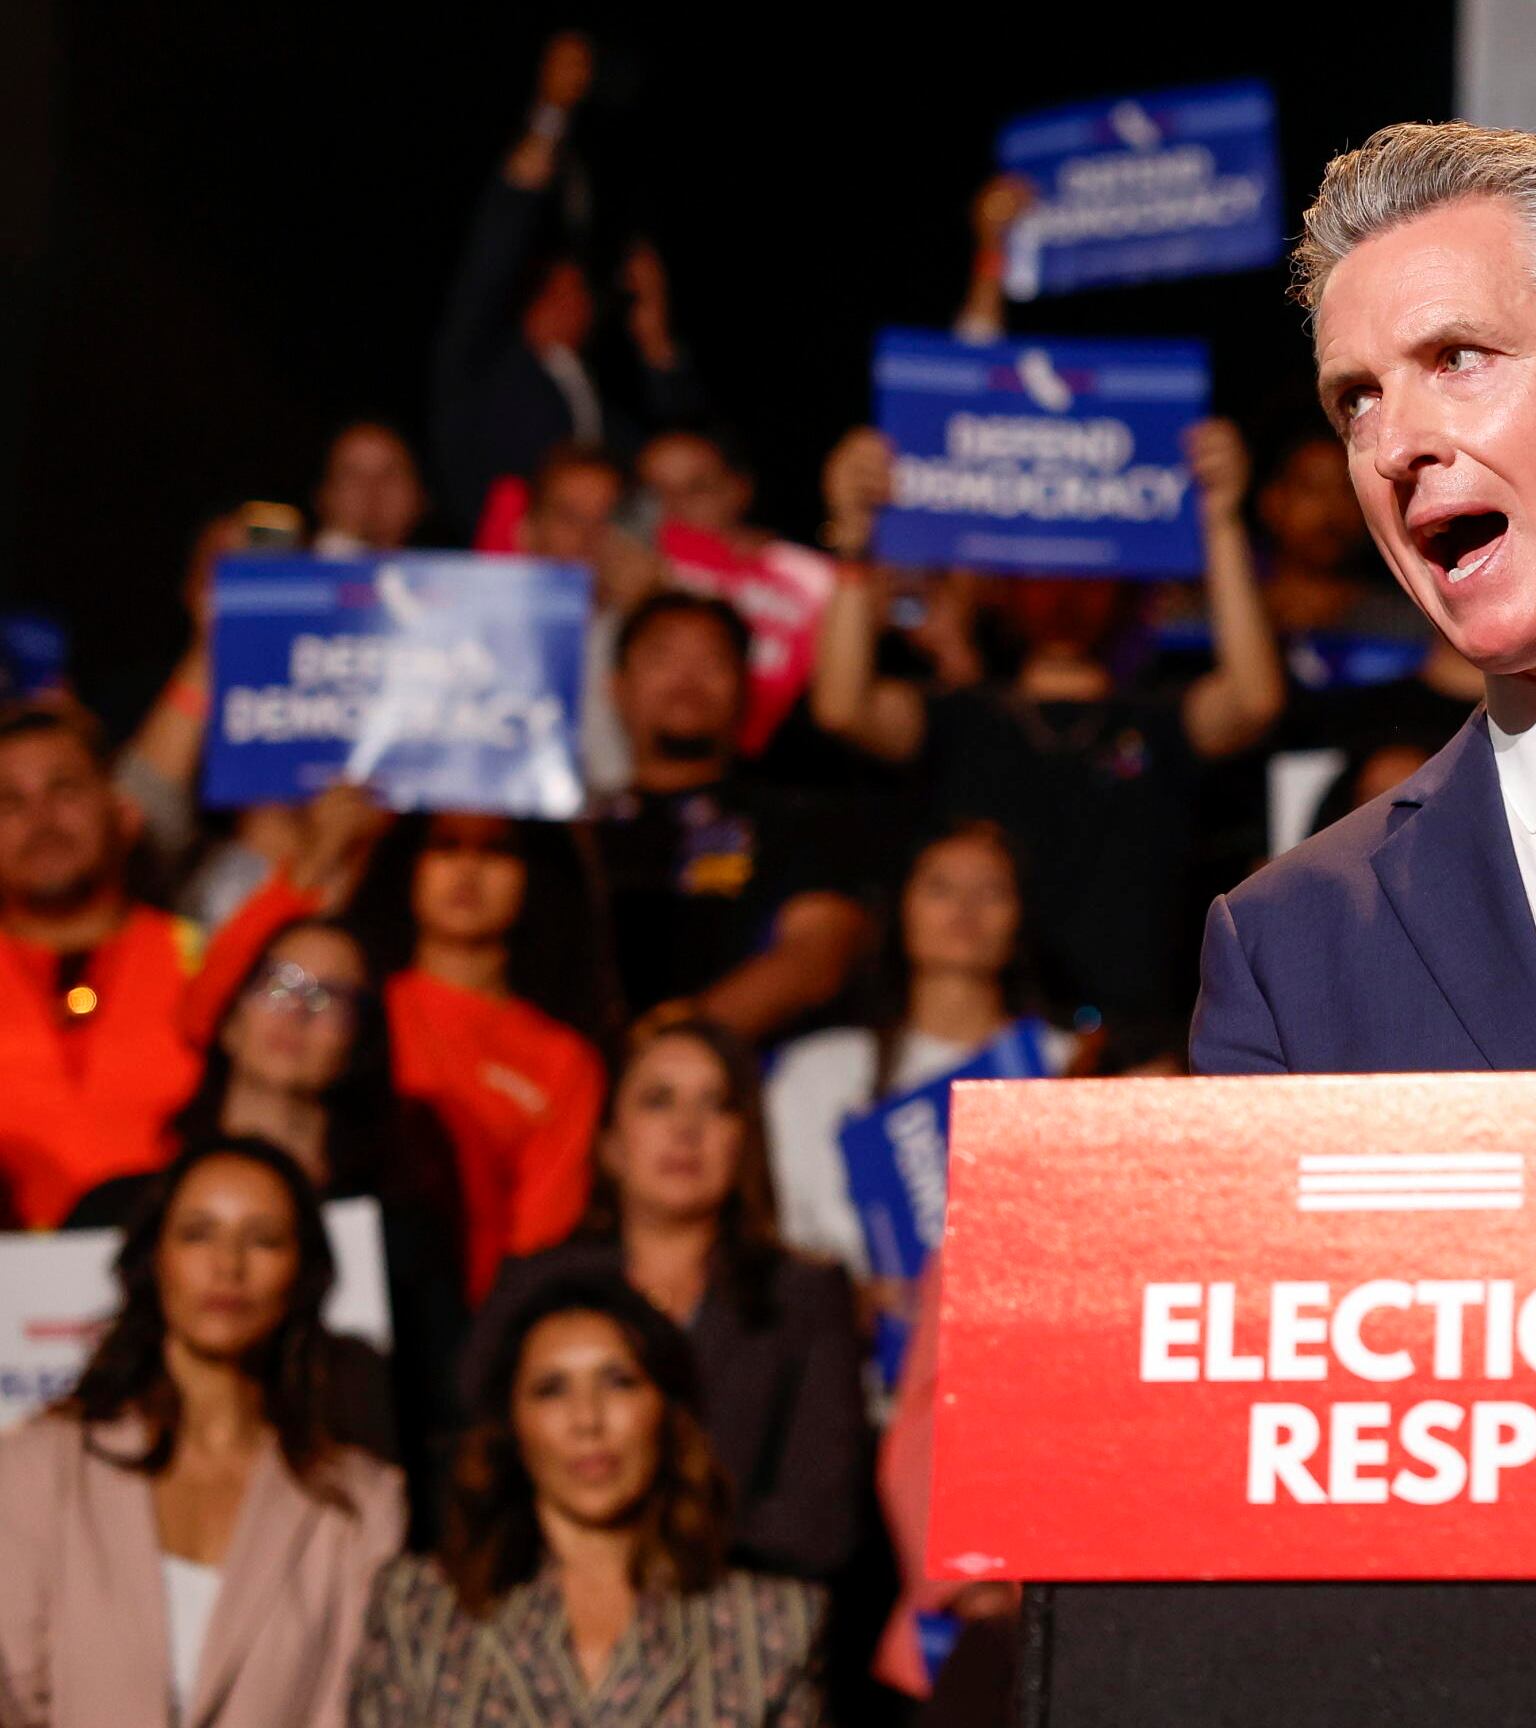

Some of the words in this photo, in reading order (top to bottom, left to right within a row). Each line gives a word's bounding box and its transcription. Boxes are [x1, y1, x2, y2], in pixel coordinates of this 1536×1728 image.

[949, 414, 1131, 470] DEFEND
[893, 458, 1190, 518] DEMOCRACY
[223, 688, 563, 747] DEMOACY
